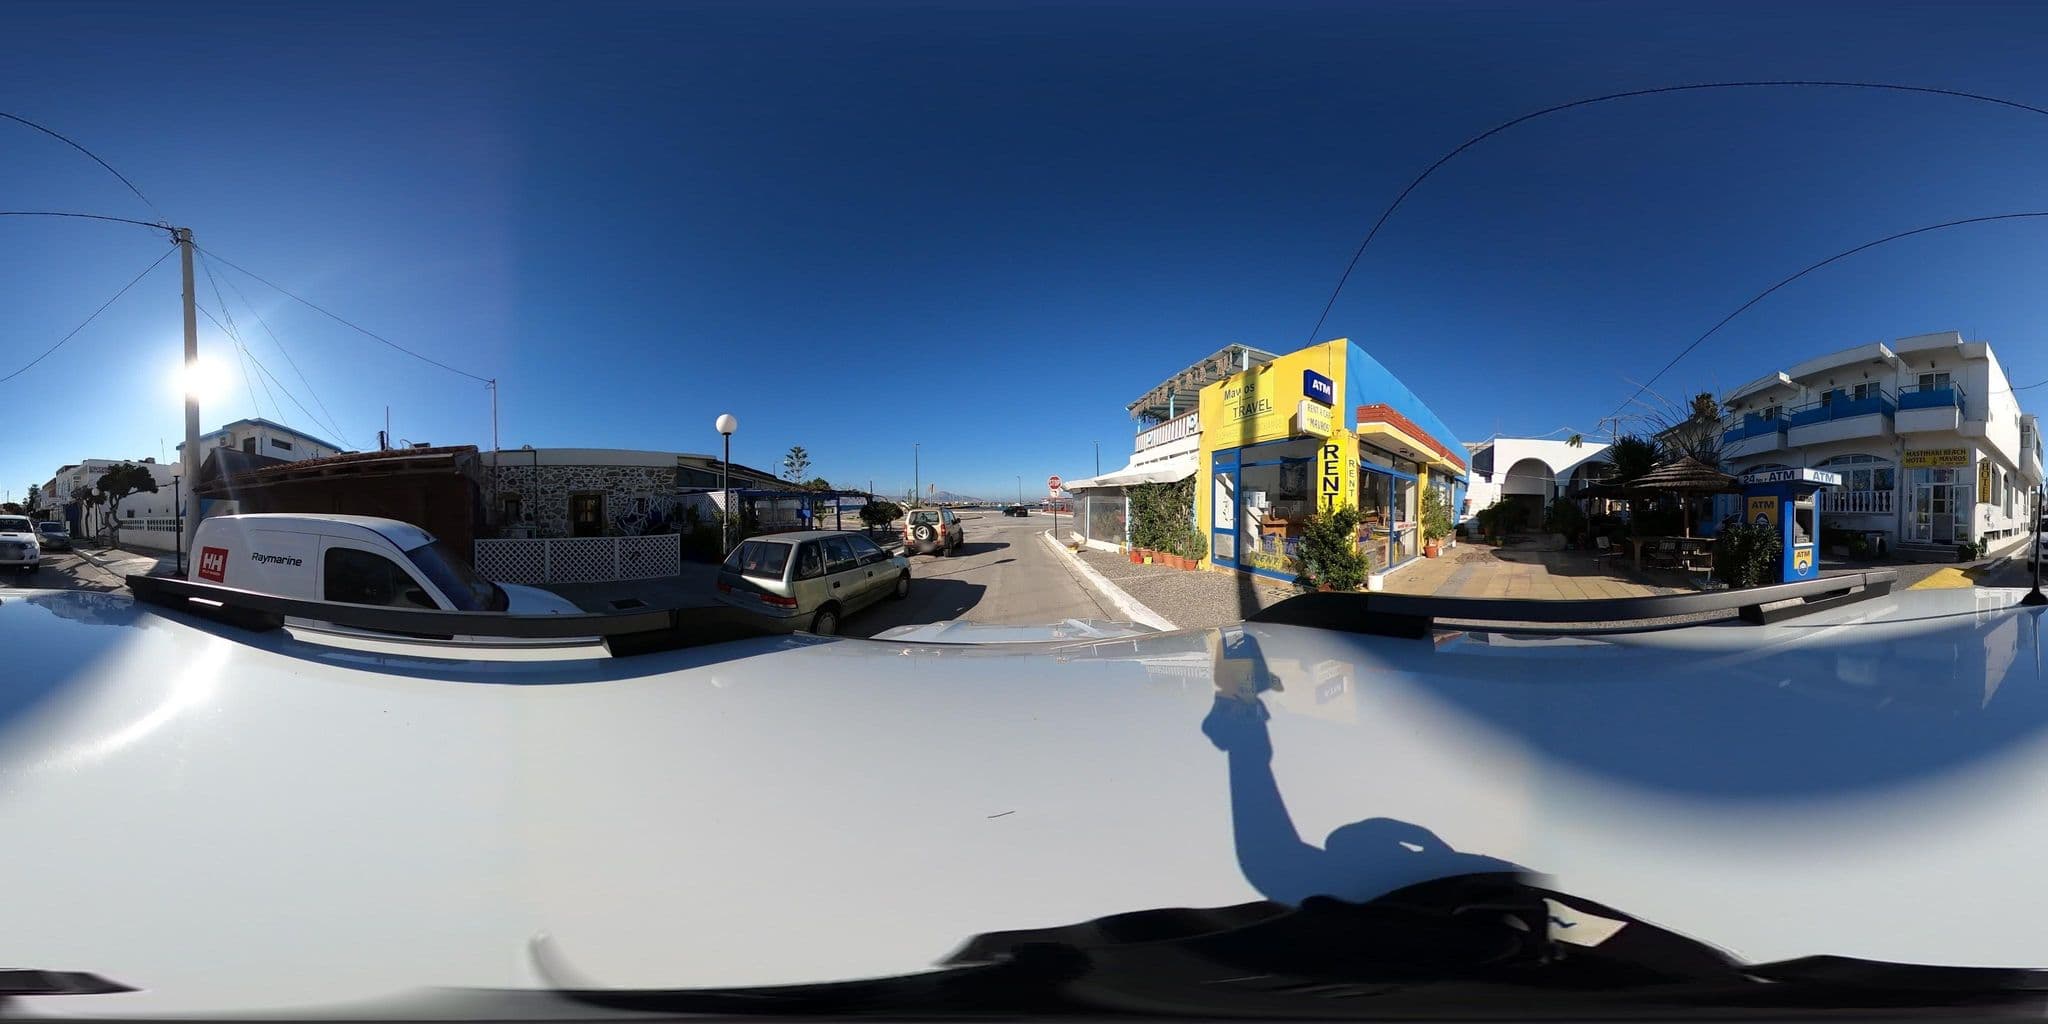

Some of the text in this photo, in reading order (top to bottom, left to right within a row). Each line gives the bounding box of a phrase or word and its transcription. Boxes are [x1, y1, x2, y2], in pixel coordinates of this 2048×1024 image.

[1312, 379, 1330, 395] ATM
[1233, 398, 1272, 418] TRAVEL
[1307, 403, 1319, 414] RENT
[1323, 444, 1339, 506] RENT
[1743, 475, 1755, 484] 24
[1769, 470, 1795, 482] ATM
[1812, 471, 1834, 484] ATM
[1751, 500, 1775, 510] ATM
[251, 552, 303, 567] Raymarine
[1796, 550, 1810, 558] ATM
[202, 552, 224, 571] HH
